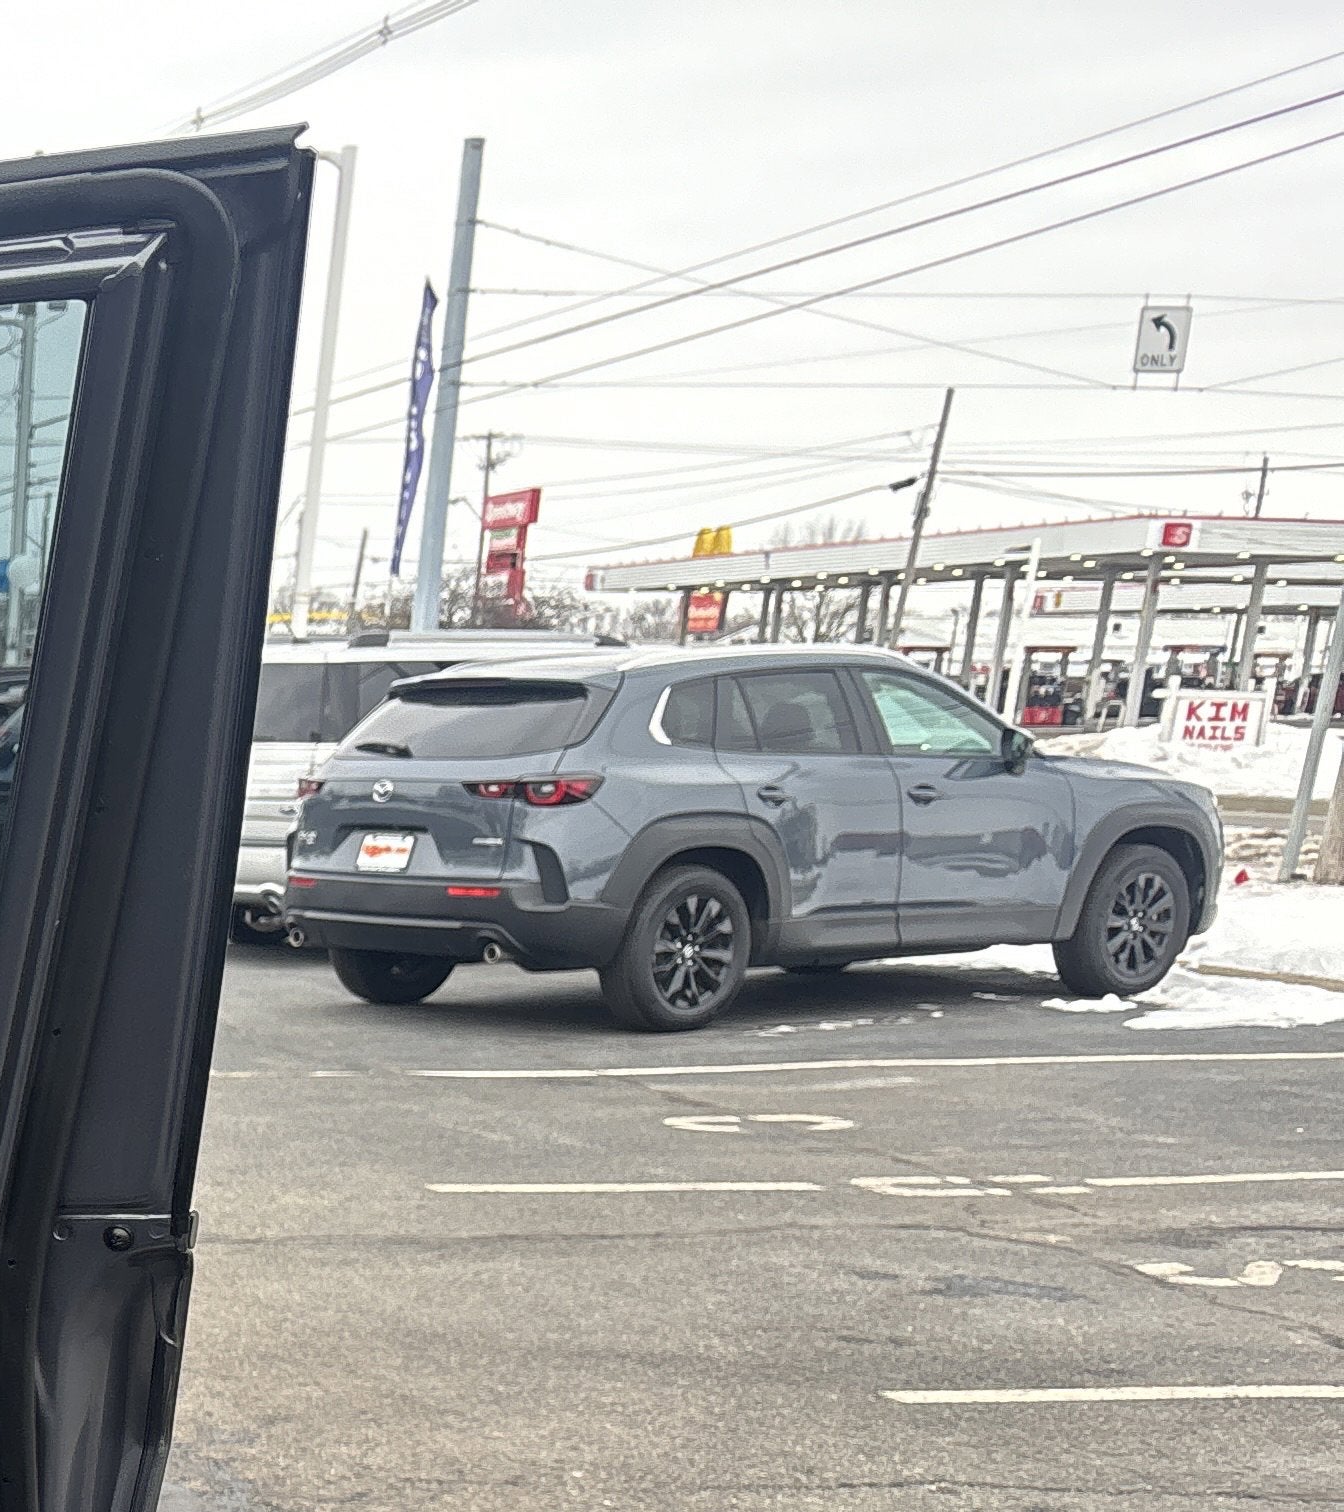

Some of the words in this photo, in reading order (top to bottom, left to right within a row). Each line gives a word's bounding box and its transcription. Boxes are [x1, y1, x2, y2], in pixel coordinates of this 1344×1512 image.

[1140, 353, 1177, 367] ONLY
[1186, 700, 1249, 722] KIM
[1182, 725, 1246, 741] NAILS
